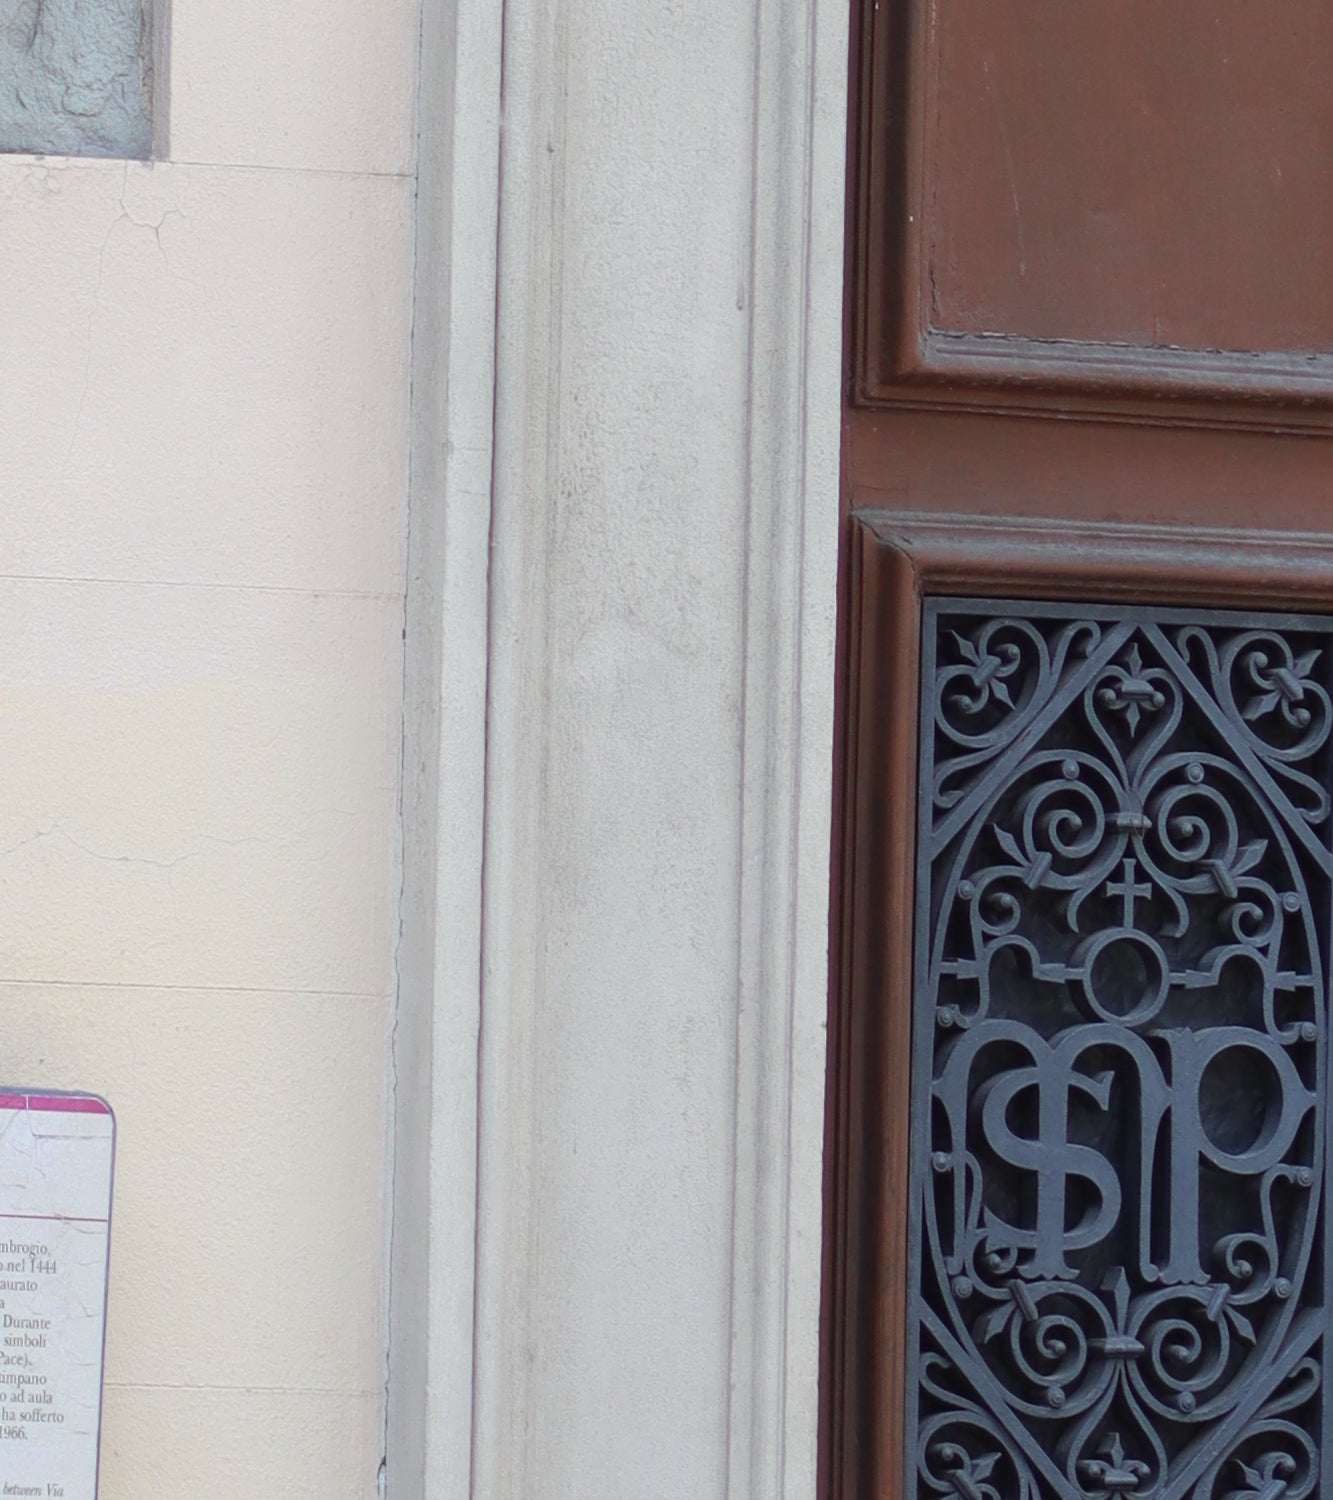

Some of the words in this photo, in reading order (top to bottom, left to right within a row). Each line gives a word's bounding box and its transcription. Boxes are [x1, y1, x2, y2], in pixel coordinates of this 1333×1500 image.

[7, 1258, 26, 1272] nel
[30, 1259, 57, 1274] 1444
[0, 1280, 38, 1291] aurato
[3, 1314, 51, 1330] Durante
[4, 1333, 47, 1348] simboli
[10, 1389, 25, 1403] ad
[27, 1389, 53, 1404] aula
[2, 1406, 16, 1421] ha
[20, 1408, 65, 1423] sofferto
[3, 1481, 42, 1497] between
[47, 1483, 64, 1497] Via
